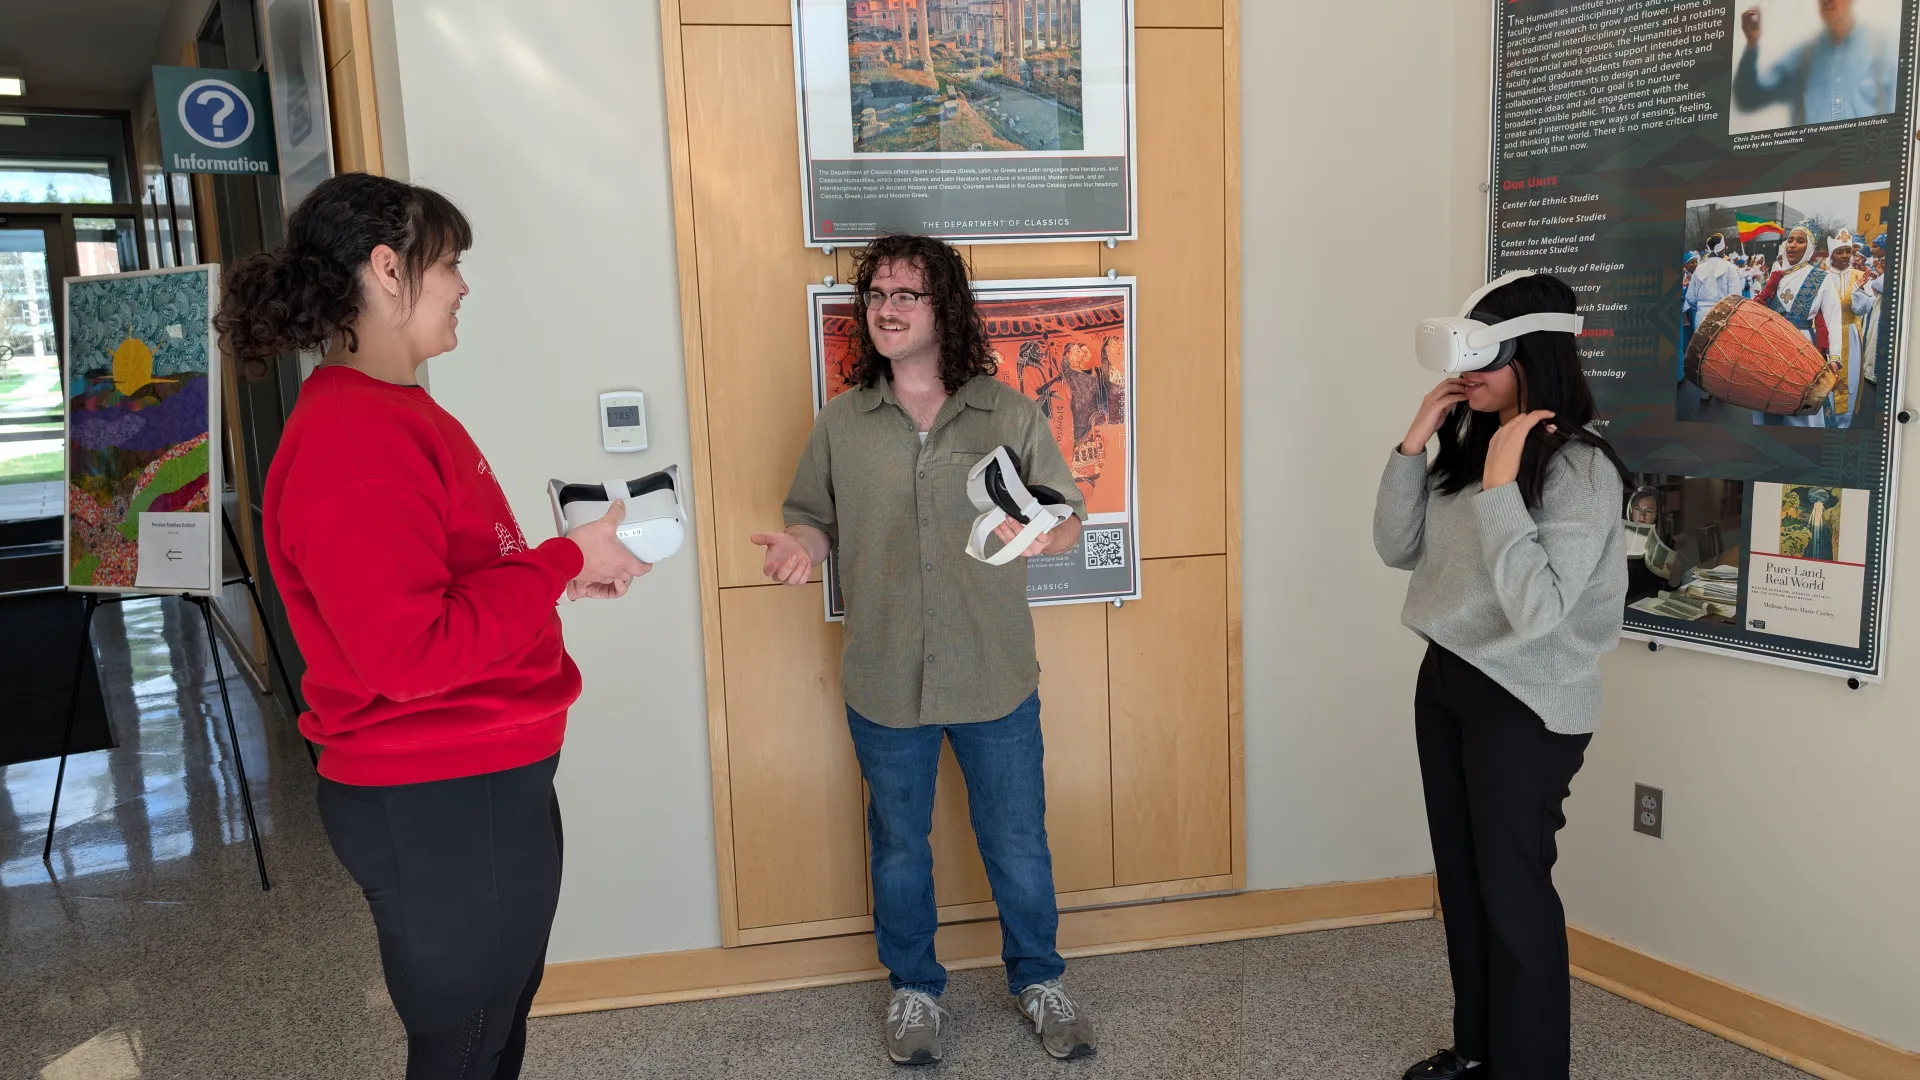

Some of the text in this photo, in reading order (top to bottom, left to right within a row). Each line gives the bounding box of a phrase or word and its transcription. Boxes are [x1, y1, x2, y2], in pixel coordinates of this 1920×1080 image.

[1508, 15, 1524, 26] The
[1526, 8, 1568, 24] Humanities
[1571, 2, 1604, 14] Institute
[1506, 33, 1536, 49] practice
[1537, 30, 1552, 41] and
[1554, 23, 1586, 37] research
[1589, 21, 1597, 30] to
[1600, 18, 1621, 30] grow
[1623, 12, 1638, 23] and
[1641, 6, 1670, 19] flower.
[1673, 0, 1700, 13] Home
[1506, 46, 1520, 57] five
[1521, 38, 1560, 54] traditional
[1562, 25, 1627, 47] interdisciplinary
[1628, 19, 1659, 32] centers
[1661, 15, 1678, 26] and
[1689, 5, 1725, 22] rotating
[1505, 29, 1724, 77] offers financial and logistics support intended to help
[1505, 42, 1712, 89] faculty and graduate students from all the Arts and
[1504, 71, 1680, 108] collaborative projects. Our goal is to nurture
[1504, 91, 1705, 128] broadest possible public. The Arts and Humanities
[1504, 101, 1712, 138] create and interrogate new ways of sensing, feeling,
[1504, 139, 1517, 148] and
[1519, 134, 1549, 148] thinking
[1552, 132, 1564, 142] the
[1566, 129, 1591, 140] world.
[1593, 125, 1616, 136] There
[1618, 124, 1625, 133] is
[1641, 121, 1663, 129] more
[1665, 114, 1694, 126] critical
[1697, 111, 1718, 122] time
[1733, 135, 1749, 143] Chris
[1749, 133, 1772, 141] Zacher,
[1773, 129, 1798, 138] founder
[1799, 127, 1807, 135] of
[1819, 122, 1856, 132] Humanities
[1858, 118, 1889, 127] Institute.
[1503, 150, 1514, 159] for
[1530, 145, 1548, 155] work
[1550, 143, 1567, 153] than
[1570, 142, 1588, 151] now.
[1733, 143, 1750, 151] Photo
[1760, 140, 1773, 148] Ann
[1773, 137, 1805, 146] Hamilton.
[173, 153, 269, 172] Information
[1502, 193, 1599, 210] Center for Ethnic Studies
[922, 218, 1069, 229] THE DEPARTMENT OF CLASSICS
[1501, 212, 1607, 229] Center for Folklore Studies
[1501, 233, 1595, 248] Center for Medieval and
[1500, 245, 1579, 258] Renaissance Studies
[1540, 266, 1553, 274] the
[1554, 265, 1577, 275] Study
[1579, 263, 1589, 272] of
[1590, 262, 1624, 273] Religion
[1576, 302, 1628, 312] wish Studies
[1581, 368, 1626, 379] echnology
[1766, 562, 1825, 579] Pure Land,
[1026, 582, 1069, 591] CLASSICS
[1765, 573, 1824, 590] Real World
